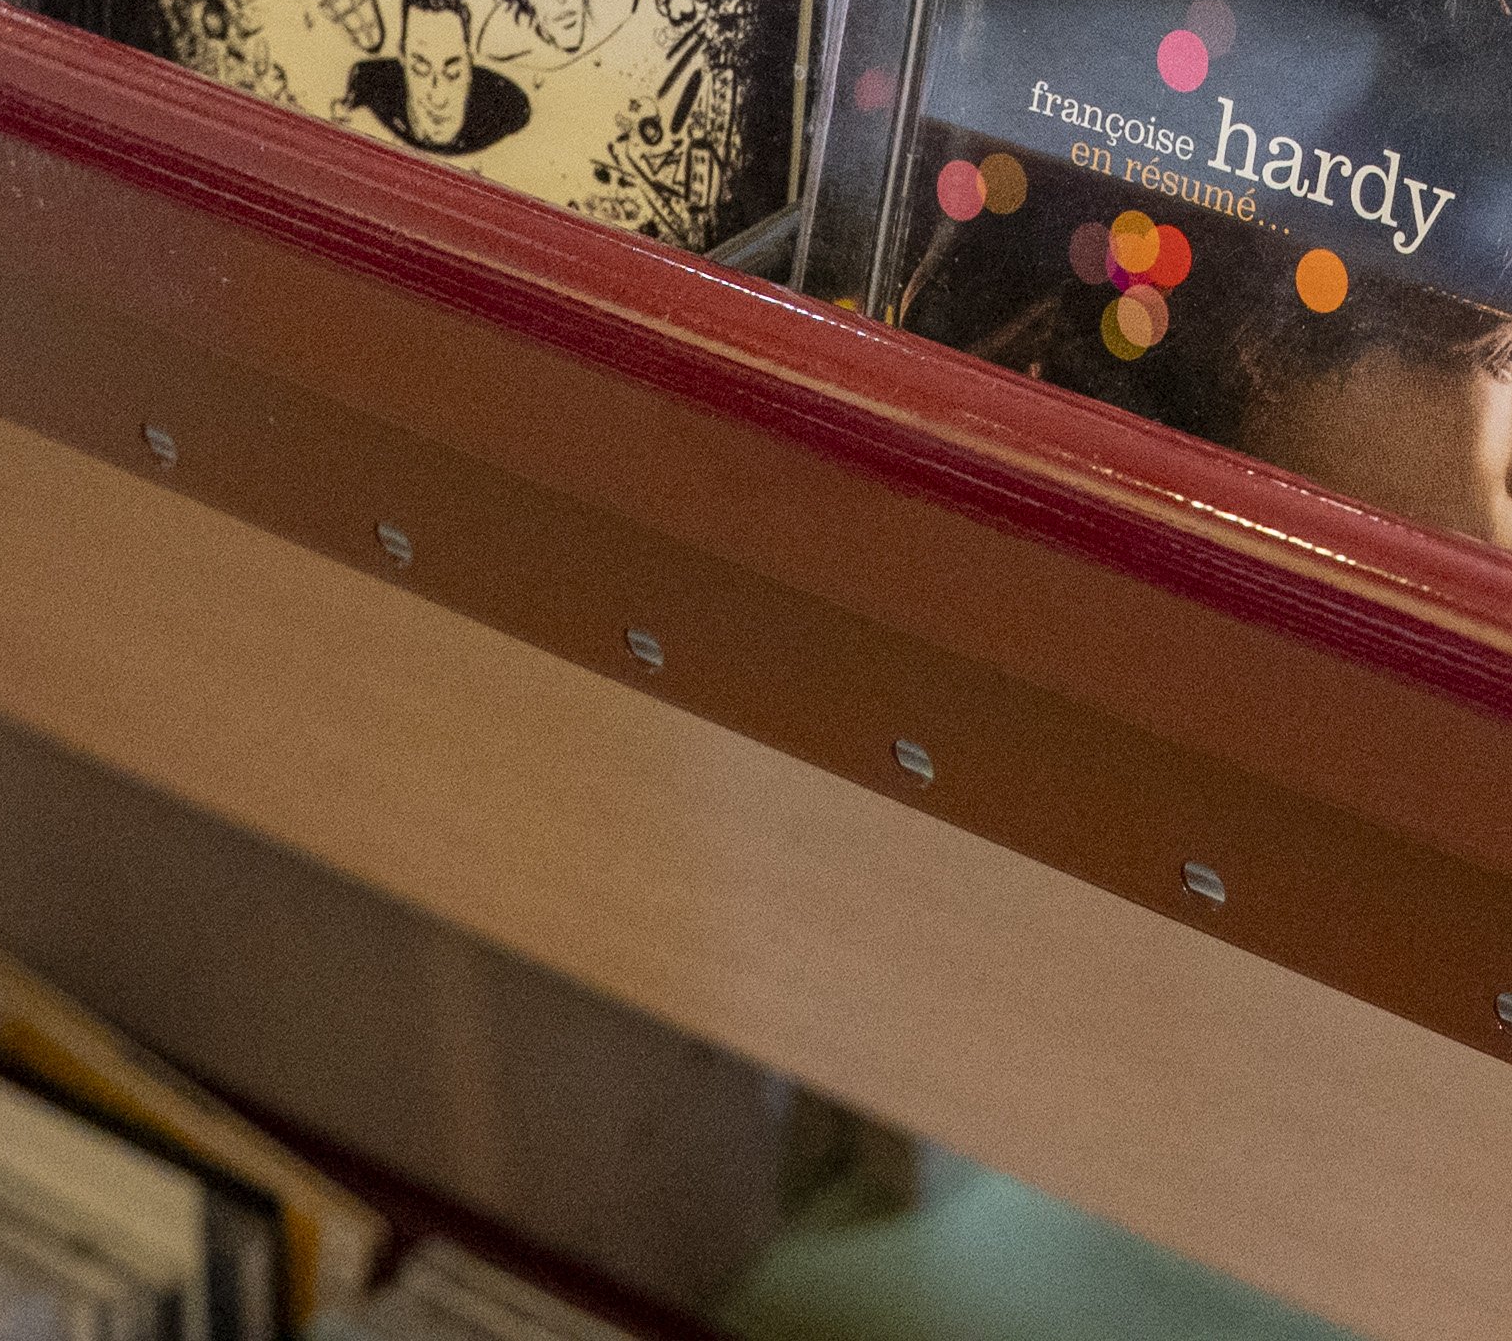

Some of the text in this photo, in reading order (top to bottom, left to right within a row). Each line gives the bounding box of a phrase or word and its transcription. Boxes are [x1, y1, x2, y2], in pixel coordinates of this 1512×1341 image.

[1027, 79, 1456, 256] françoise hardy
[1070, 139, 1115, 177] en
